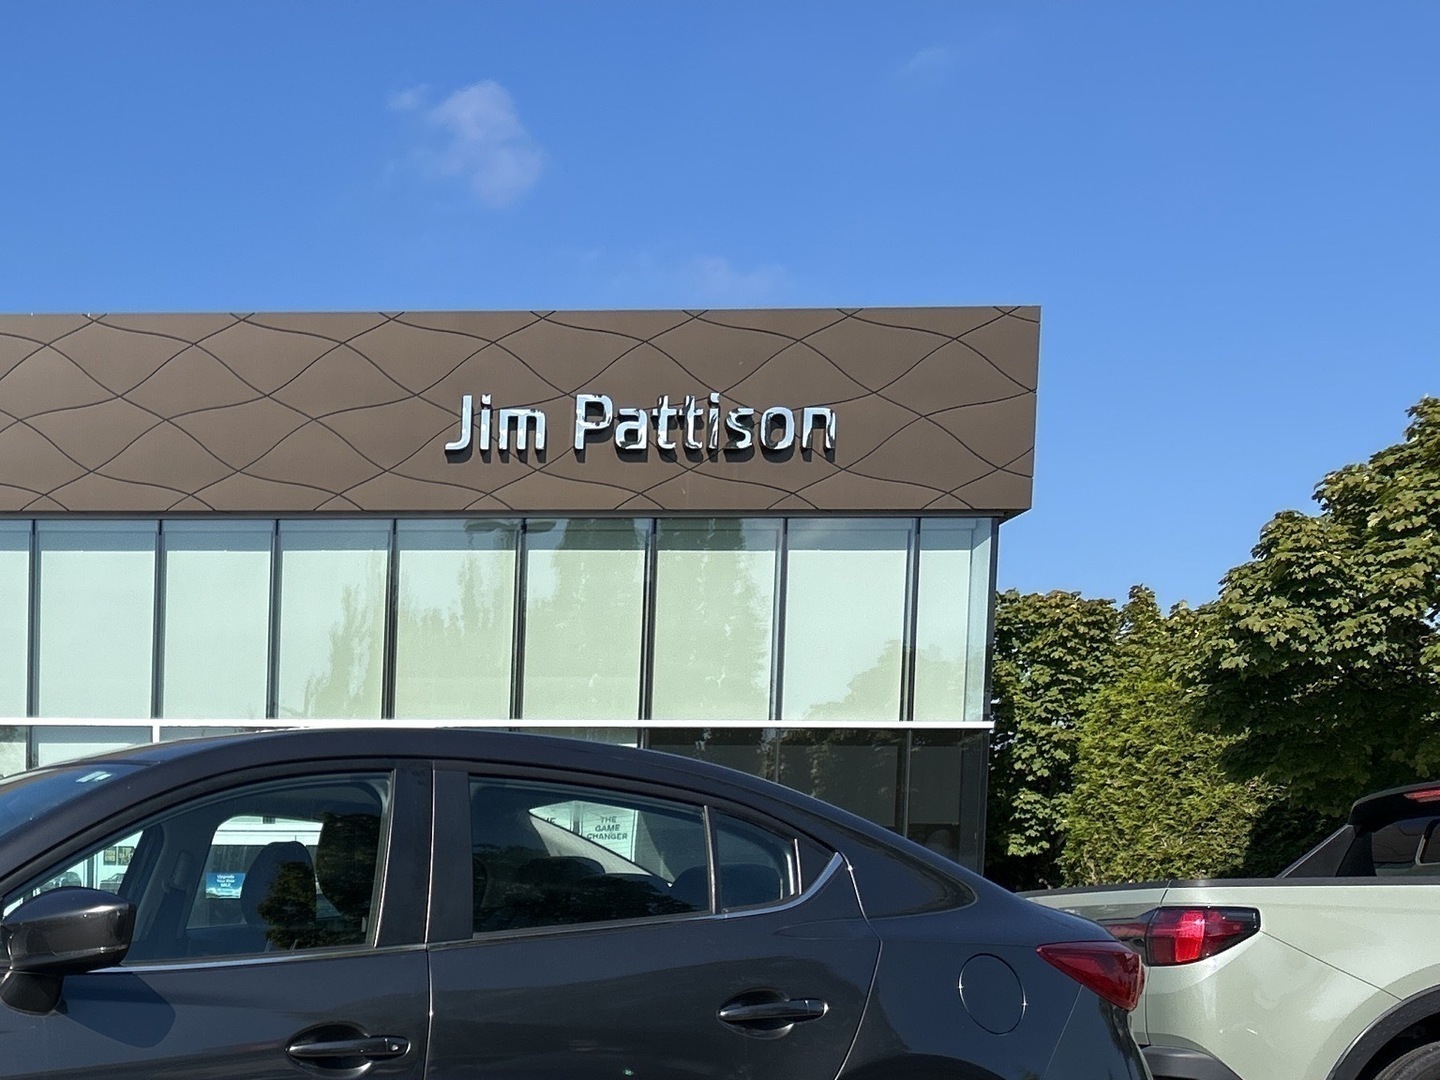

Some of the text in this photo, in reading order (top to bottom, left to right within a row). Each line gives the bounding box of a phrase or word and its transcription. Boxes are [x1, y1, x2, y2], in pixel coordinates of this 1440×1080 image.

[444, 392, 837, 452] Jim Pattison
[600, 816, 617, 824] THE
[595, 824, 620, 832] GAME
